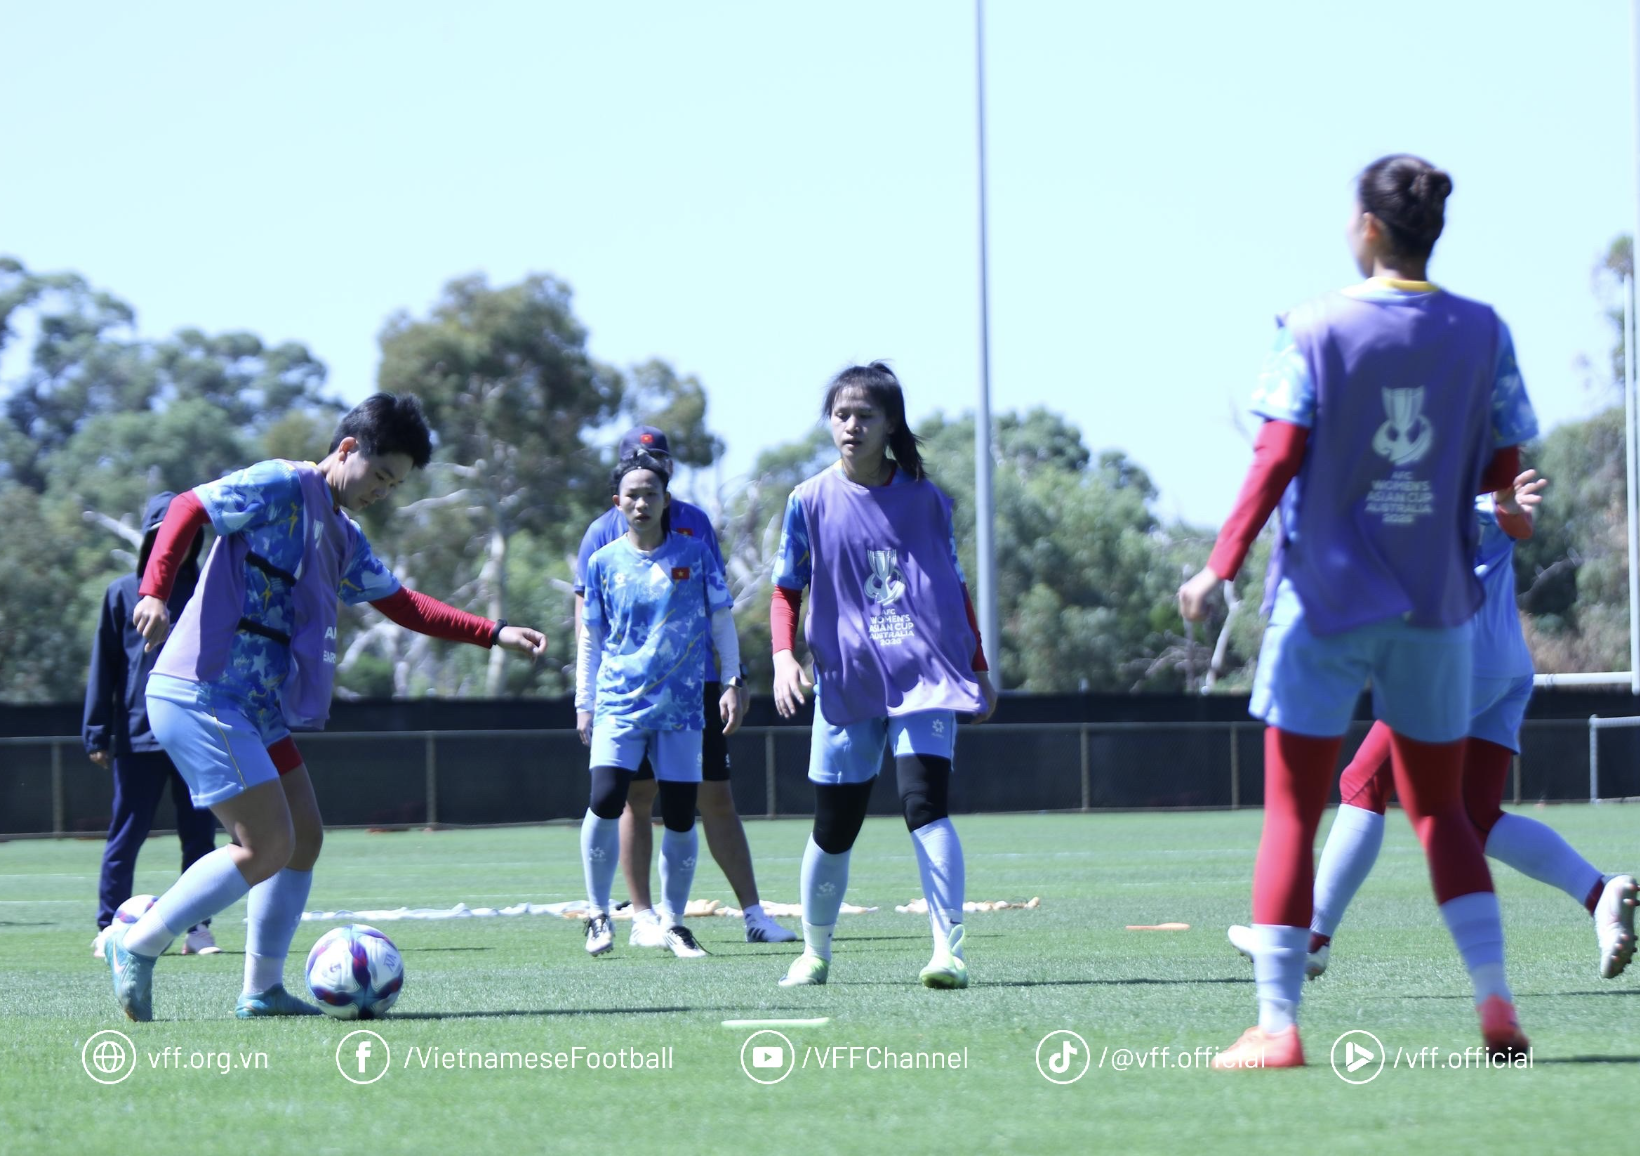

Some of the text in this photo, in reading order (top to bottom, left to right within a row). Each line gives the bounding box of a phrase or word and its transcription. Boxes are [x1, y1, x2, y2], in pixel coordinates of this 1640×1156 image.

[870, 615, 911, 624] WOMEN'S
[869, 622, 914, 633] ASIAN CUP
